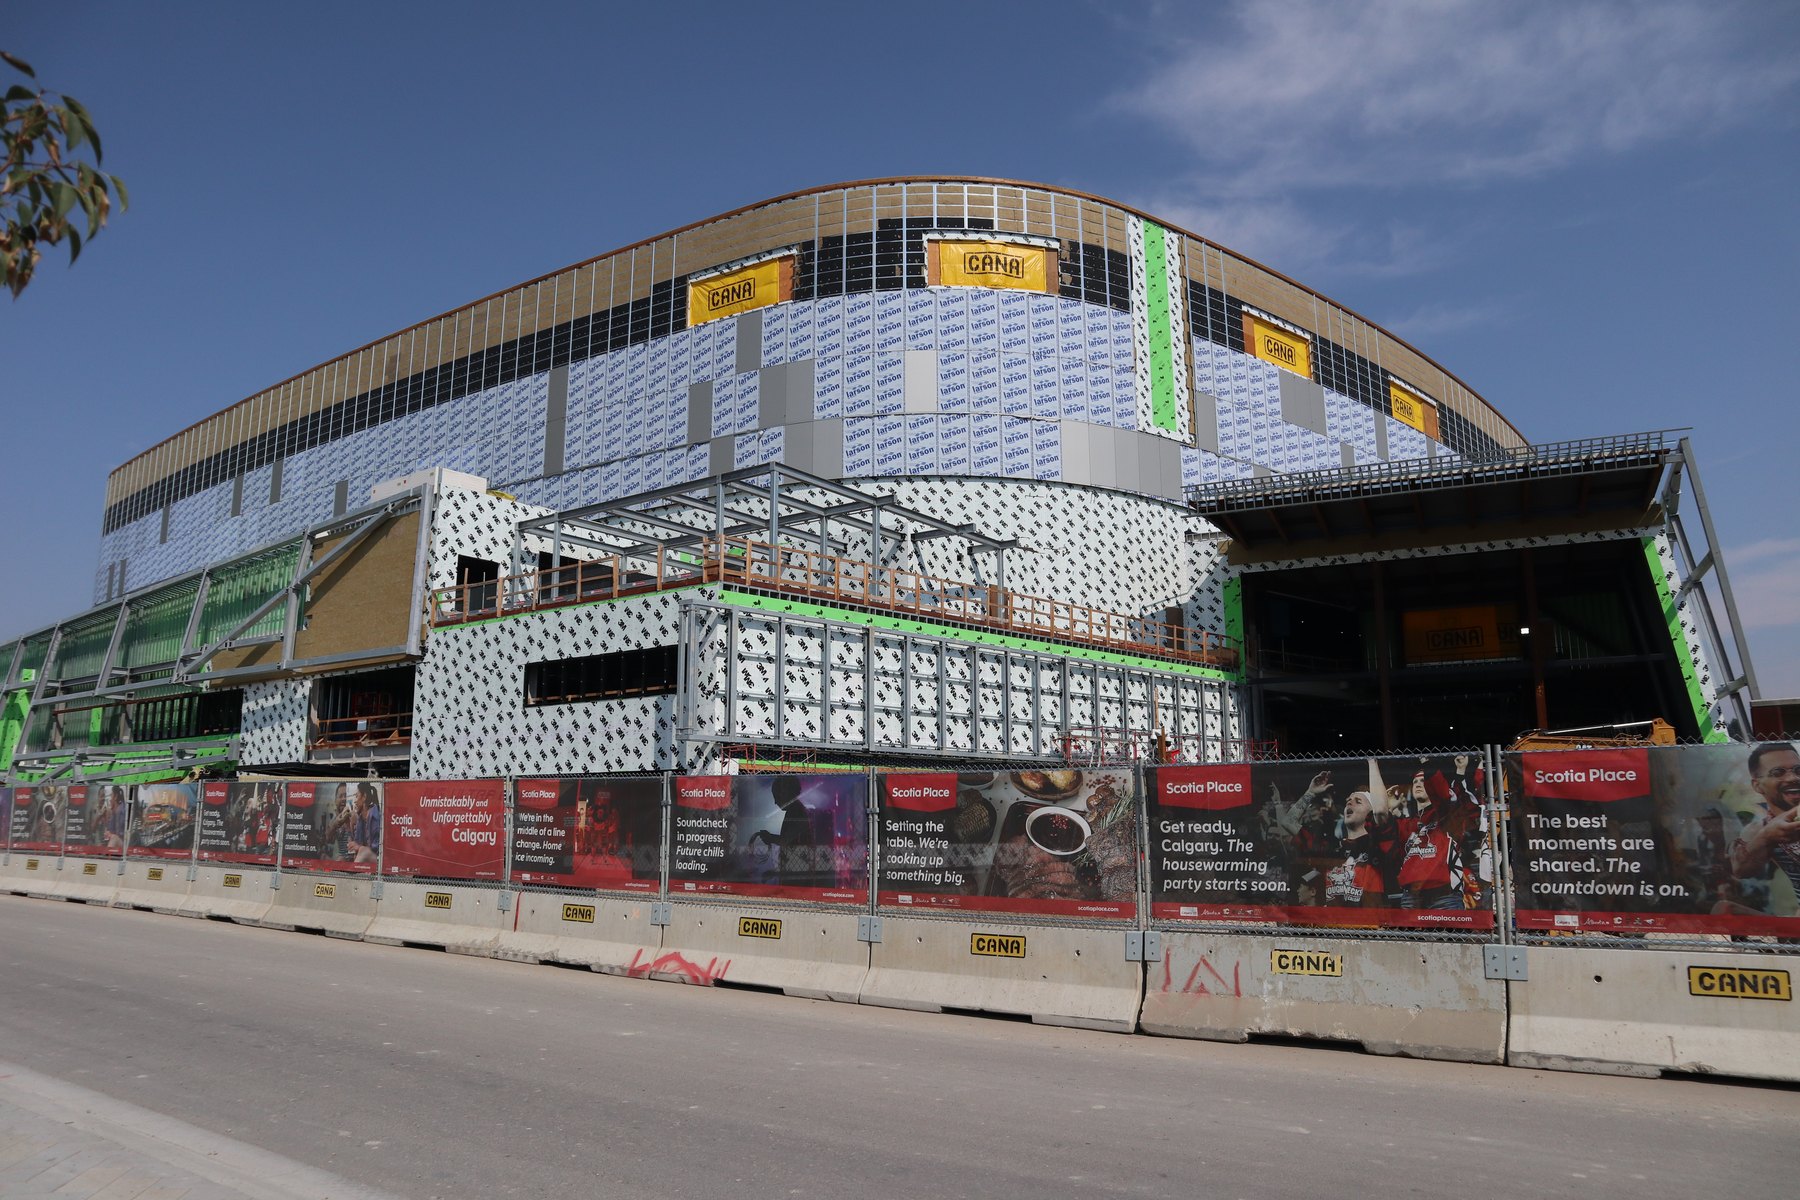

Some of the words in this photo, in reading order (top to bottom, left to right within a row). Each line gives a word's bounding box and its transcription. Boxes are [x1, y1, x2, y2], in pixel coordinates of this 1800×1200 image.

[969, 257, 1020, 275] CANA
[712, 282, 751, 307] CANA
[877, 292, 902, 306] larson
[940, 294, 964, 307] larson
[1001, 294, 1025, 305] larson
[817, 299, 841, 313] larson
[971, 304, 995, 316] larson
[1031, 303, 1053, 315] larson
[847, 315, 871, 329] larson
[908, 314, 933, 327] larson
[715, 322, 736, 337] larson
[877, 321, 902, 335] larson
[940, 323, 964, 337] larson
[672, 332, 691, 348] larson
[817, 328, 841, 342] larson
[972, 332, 996, 345] larson
[1002, 337, 1025, 349] larson
[1267, 339, 1294, 362] CANA
[817, 368, 840, 383] larson
[877, 372, 902, 386] larson
[1090, 376, 1109, 386] larson
[846, 384, 870, 400] larson
[940, 382, 965, 395] larson
[972, 380, 997, 393] larson
[1003, 387, 1027, 399] larson
[1062, 389, 1084, 400] larson
[816, 398, 839, 412] larson
[1395, 398, 1413, 418] CANA
[846, 429, 870, 442] larson
[941, 426, 966, 439] larson
[973, 424, 998, 438] larson
[1035, 424, 1059, 435] larson
[760, 431, 782, 445] larson
[876, 437, 902, 451] larson
[909, 431, 934, 444] larson
[761, 447, 782, 460] larson
[1004, 444, 1028, 456] larson
[846, 458, 870, 473] larson
[909, 461, 934, 474] larson
[941, 456, 966, 469] larson
[973, 455, 998, 468] larson
[1036, 470, 1059, 480] larson
[1432, 631, 1479, 646] CANA
[1535, 770, 1586, 783] Scotia
[1590, 769, 1636, 782] Place
[522, 790, 538, 798] Scotia
[681, 788, 703, 797] Scotia
[705, 788, 725, 798] Place
[892, 788, 921, 797] Scotia
[923, 788, 950, 797] Place
[1166, 783, 1204, 794] Scotia
[1207, 782, 1242, 793] Place
[420, 796, 475, 809] Unmistakably
[391, 814, 412, 825] Scotia
[433, 811, 492, 825] Unforgettably
[520, 813, 535, 822] We're
[536, 813, 542, 821] in
[543, 814, 553, 822] the
[677, 818, 727, 828] Soundcheck
[1527, 814, 1562, 828] The
[1566, 814, 1608, 828] best
[401, 827, 420, 837] Place
[518, 826, 538, 835] middle
[539, 828, 546, 836] of
[553, 828, 565, 836] line
[886, 820, 923, 834] Setting
[926, 821, 944, 832] the
[1161, 821, 1184, 834] Get
[1188, 821, 1236, 836] ready,
[452, 828, 496, 845] Calgary
[678, 832, 685, 841] in
[686, 834, 724, 844] progress.
[886, 837, 916, 848] table.
[919, 838, 949, 849] We're
[516, 840, 541, 850] change.
[543, 841, 562, 850] Home
[1162, 839, 1223, 854] Calgary.
[1227, 840, 1253, 852] The
[1529, 837, 1617, 850] moments
[1621, 838, 1654, 850] are
[677, 846, 701, 857] Future
[703, 847, 724, 857] chills
[515, 852, 524, 861] ice
[526, 853, 555, 865] incoming.
[886, 854, 926, 867] cooking
[930, 856, 943, 867] up
[1530, 858, 1600, 872] shared.
[1606, 858, 1640, 872] The
[676, 860, 708, 872] loading.
[1162, 858, 1267, 874] housewarming
[226, 876, 240, 885] CANA
[886, 870, 941, 885] something
[945, 872, 965, 884] big.
[316, 885, 334, 896] CANA
[1163, 878, 1202, 893] party
[1205, 878, 1247, 890] starts
[1251, 879, 1290, 892] soon.
[1532, 880, 1634, 895] countdown
[1640, 881, 1653, 896] is
[1660, 883, 1689, 896] on.
[428, 894, 449, 906] CANA
[566, 907, 591, 919] CANA
[743, 921, 777, 935] CANA
[977, 938, 1020, 953] CANA
[1278, 955, 1335, 972] CANA
[1700, 972, 1781, 994] CANA
